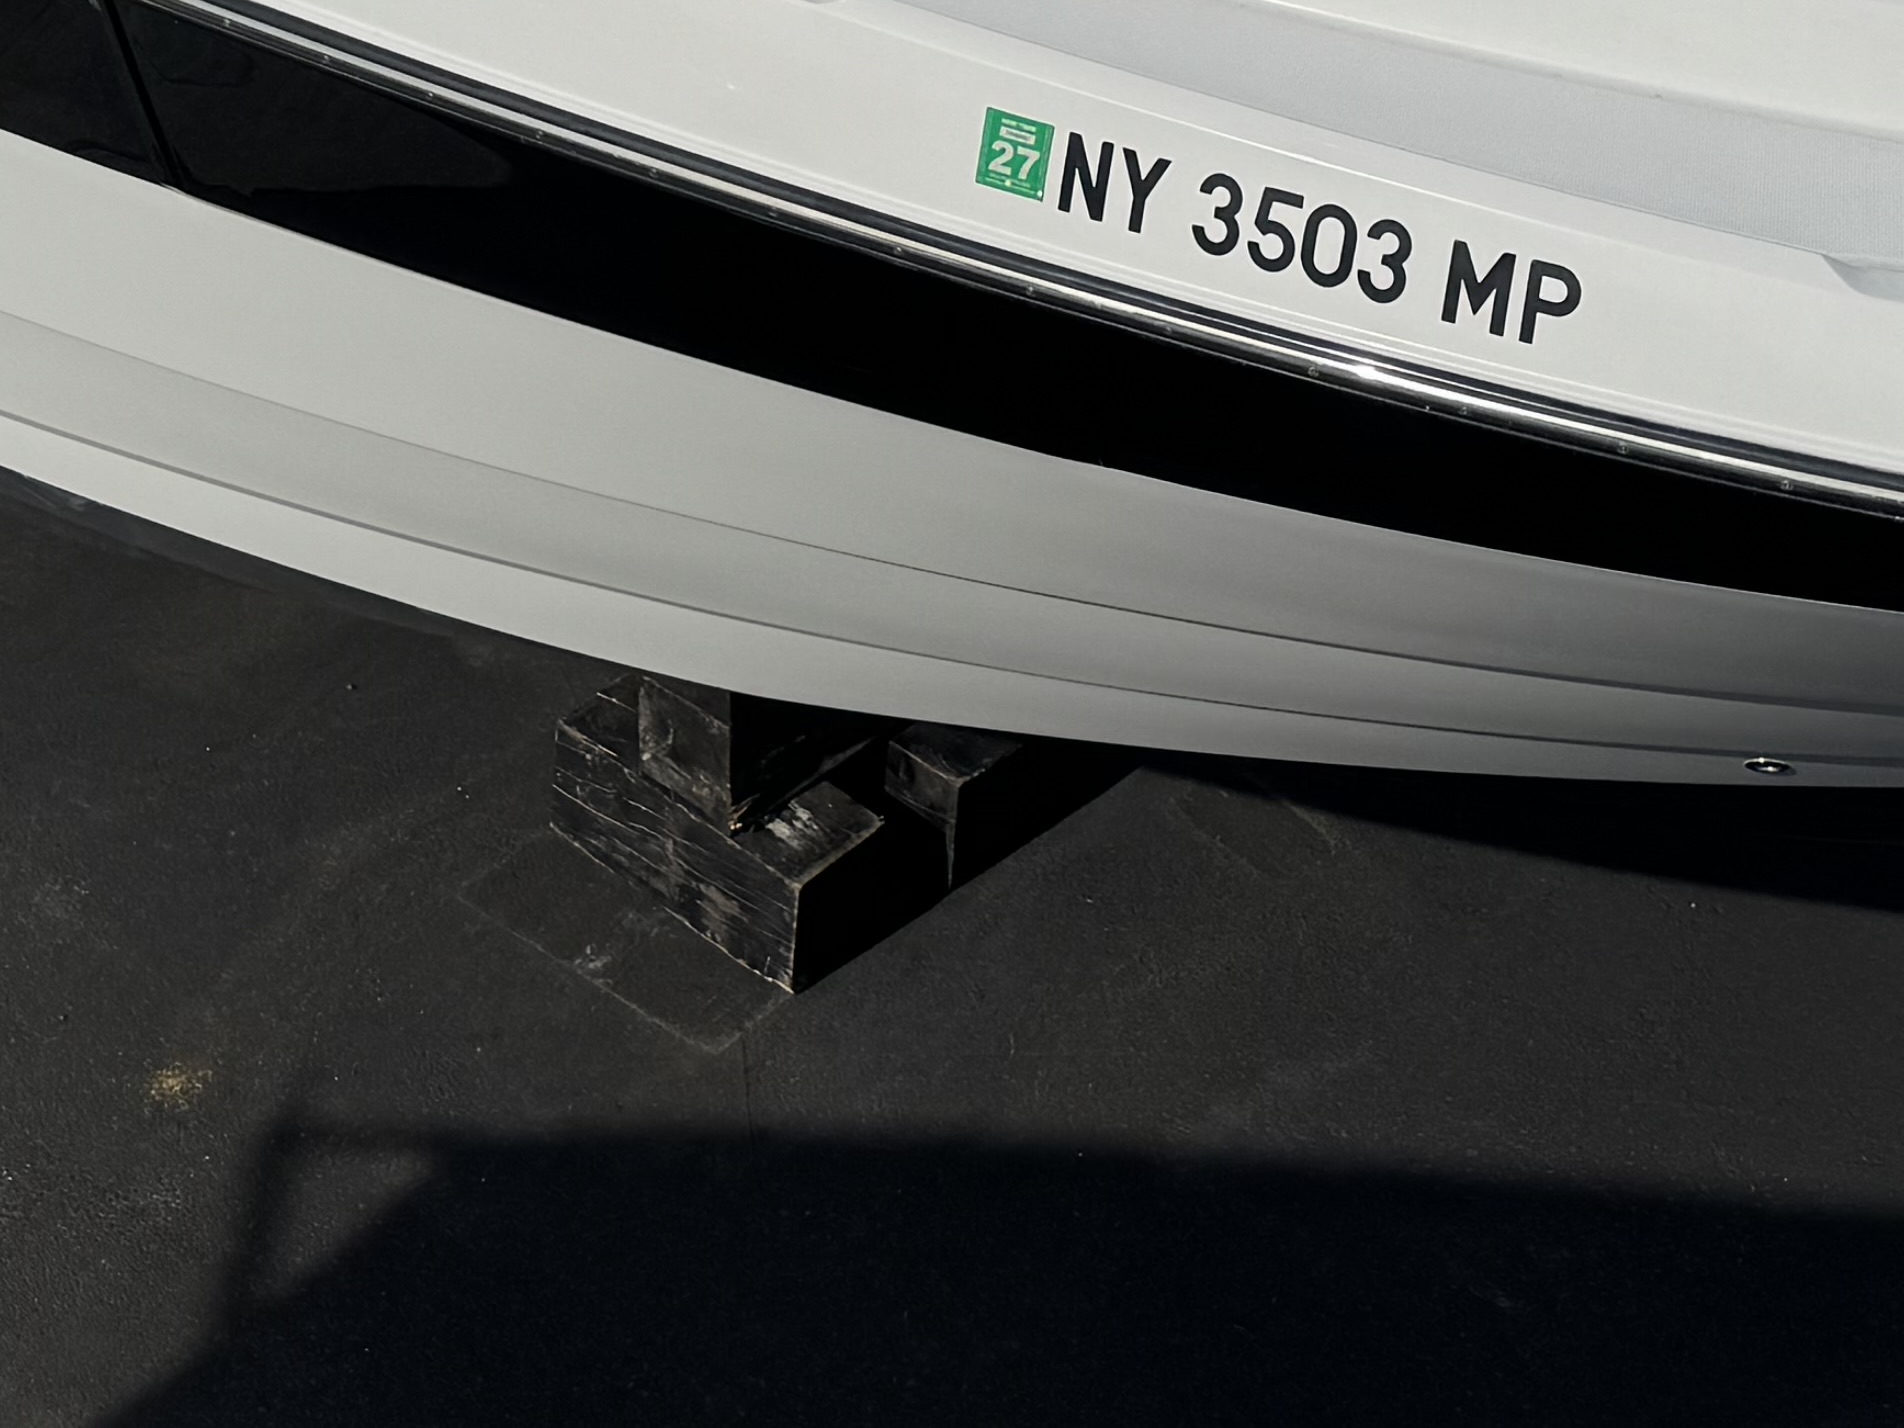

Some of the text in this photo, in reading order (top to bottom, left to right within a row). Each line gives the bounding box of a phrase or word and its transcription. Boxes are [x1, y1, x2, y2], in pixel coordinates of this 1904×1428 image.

[988, 140, 1041, 180] 27
[1057, 131, 1582, 345] NY 3503 MP
